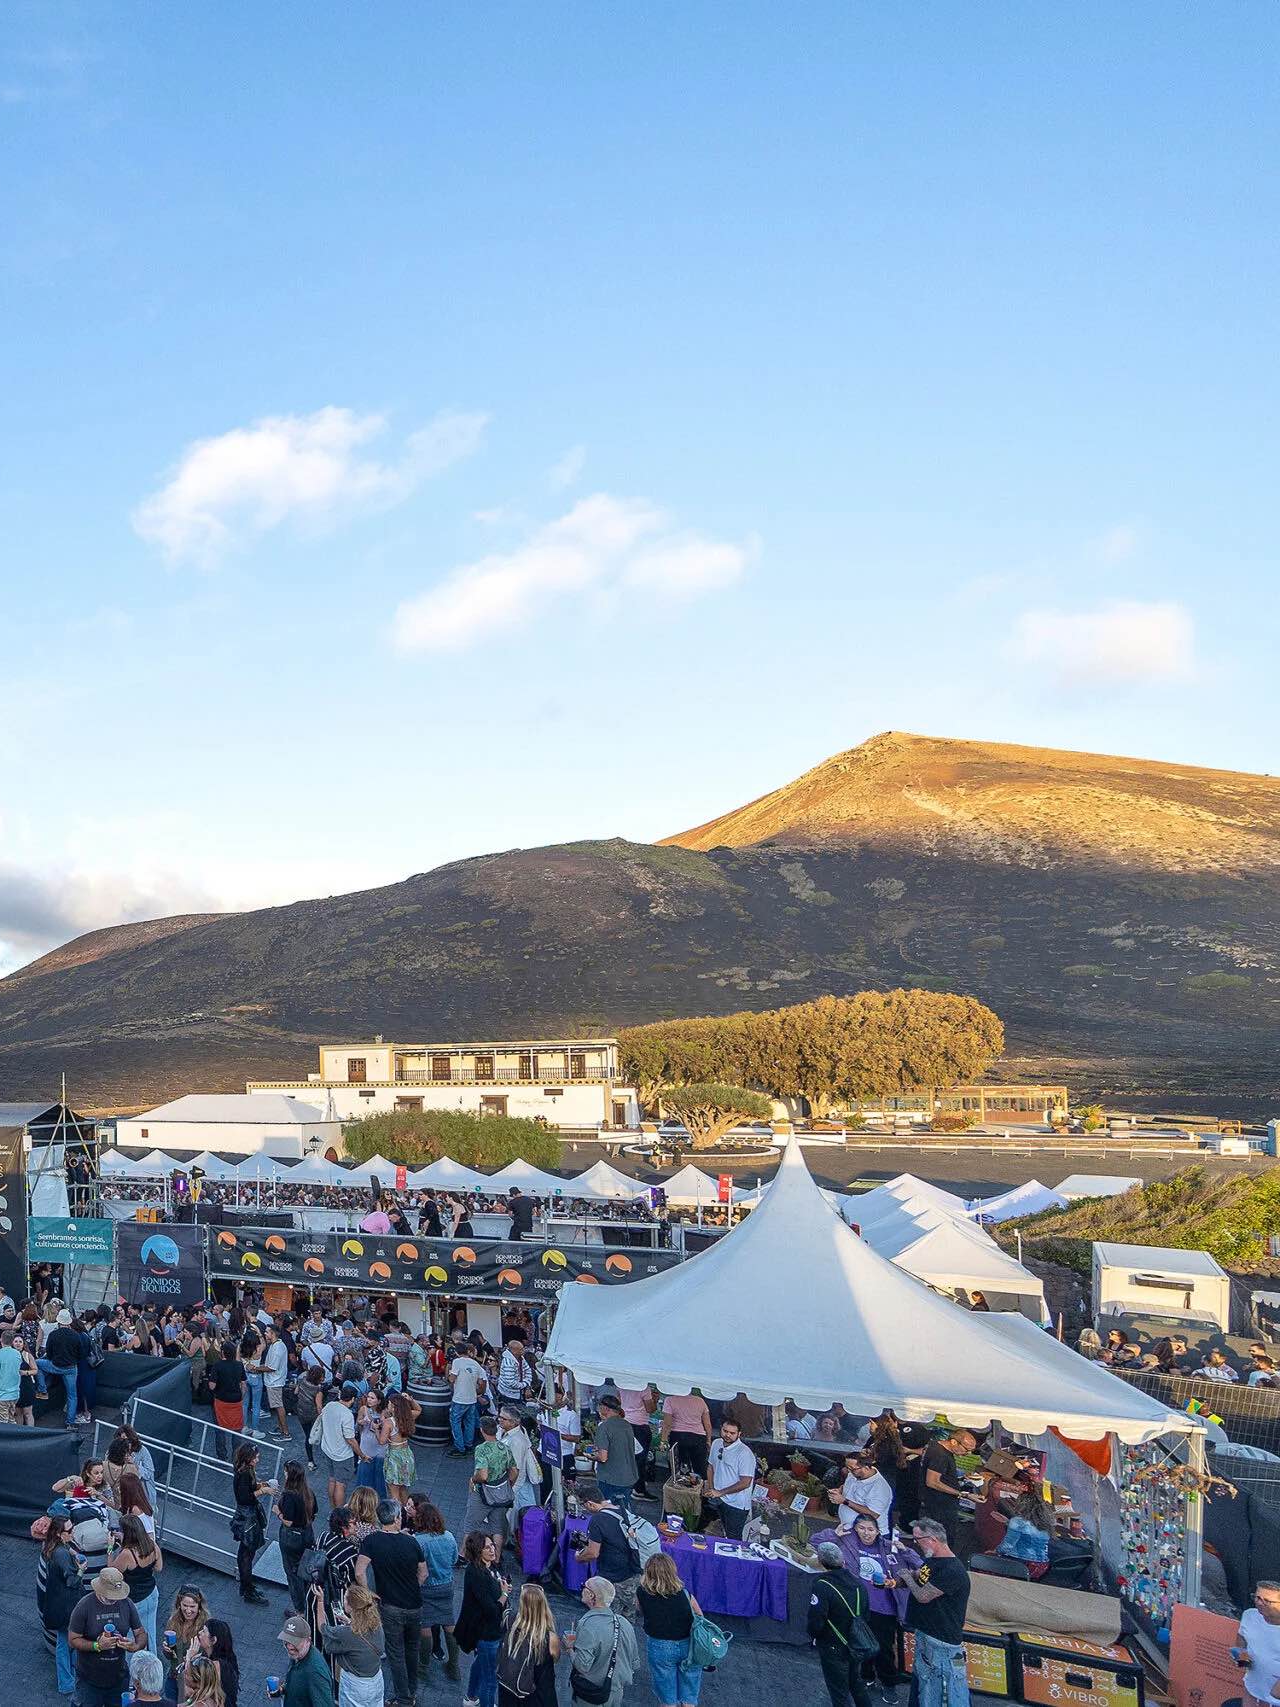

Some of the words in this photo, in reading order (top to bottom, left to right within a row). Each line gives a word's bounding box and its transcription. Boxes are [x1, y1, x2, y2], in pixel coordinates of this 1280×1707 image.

[37, 1233, 78, 1242] Sembramos
[78, 1235, 106, 1244] sonrisas,
[35, 1240, 71, 1249] cultivamos
[71, 1242, 109, 1251] conciencias
[141, 1276, 181, 1287] SONIDOS
[534, 1278, 563, 1286] SONIDOS
[1062, 1688, 1109, 1707] VIBRO
